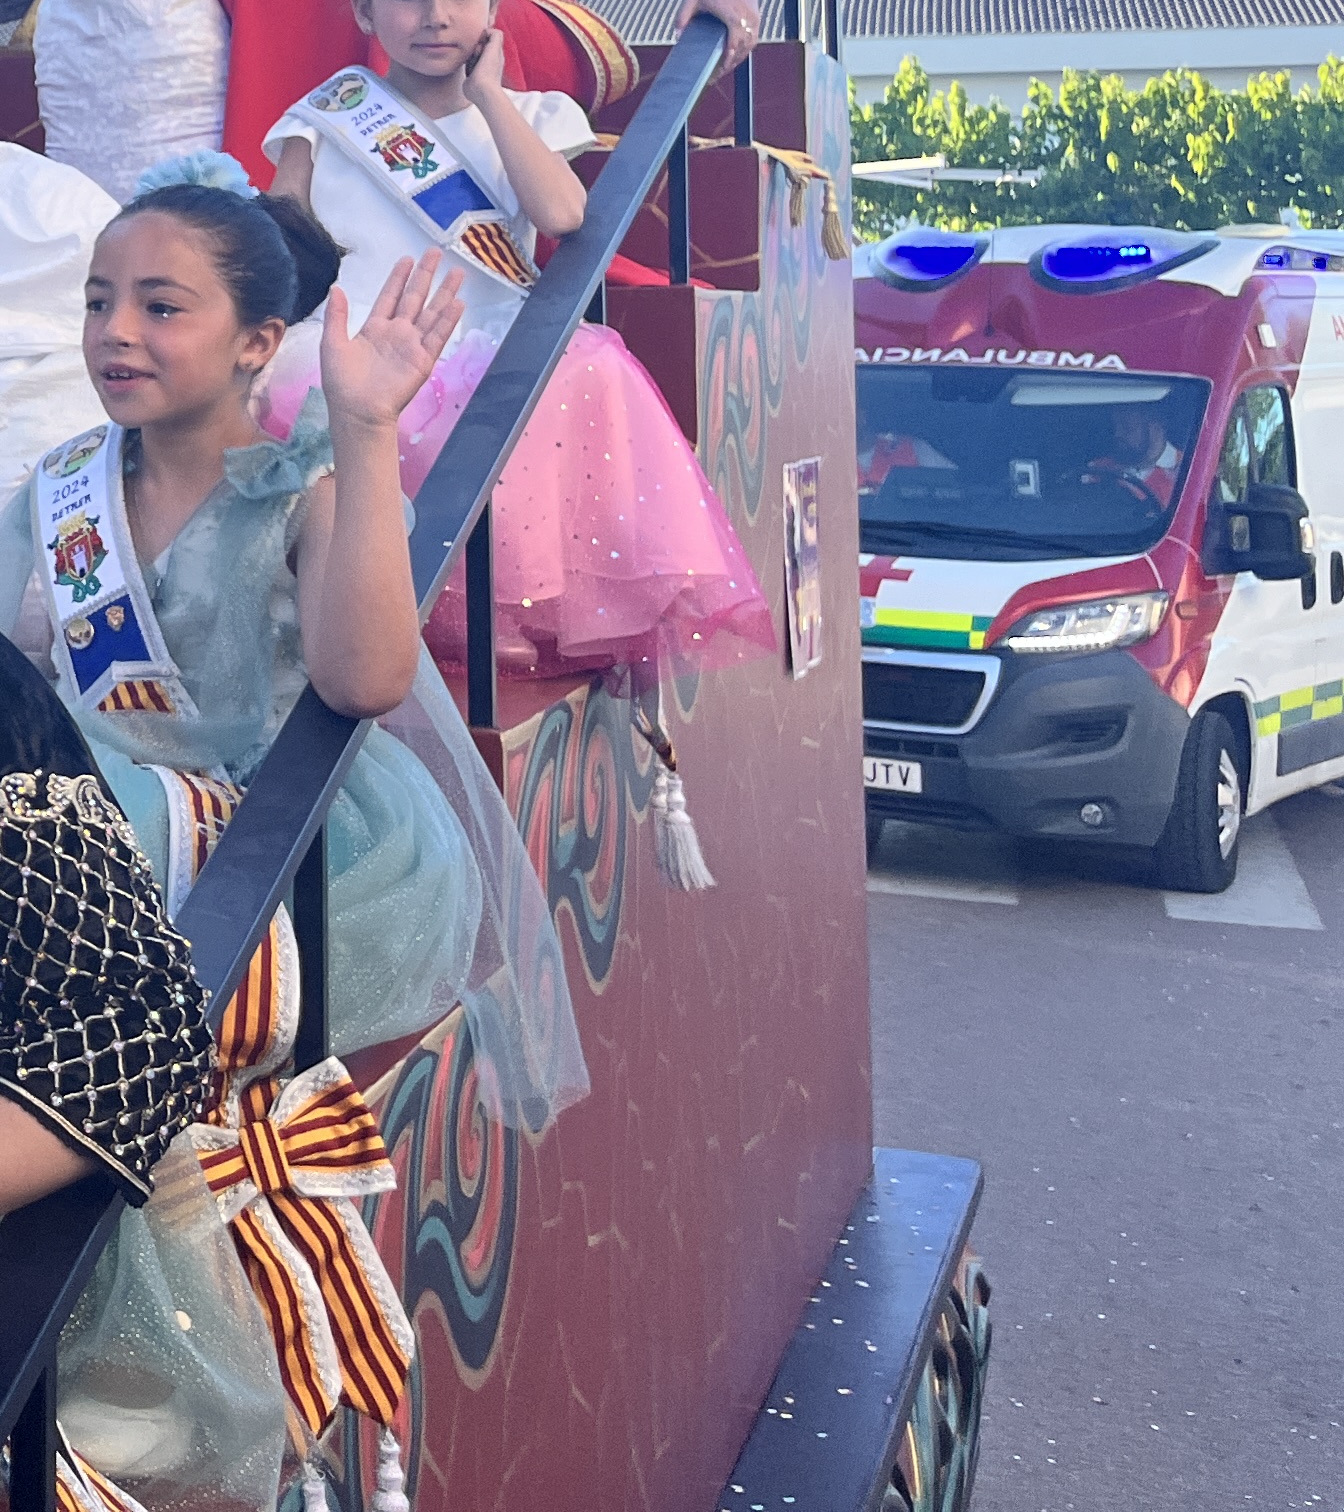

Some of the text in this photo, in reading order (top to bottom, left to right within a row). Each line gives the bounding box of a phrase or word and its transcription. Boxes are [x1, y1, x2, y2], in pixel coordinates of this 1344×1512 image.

[351, 103, 383, 127] 2024
[52, 475, 90, 505] 2024
[865, 762, 910, 787] JTV
